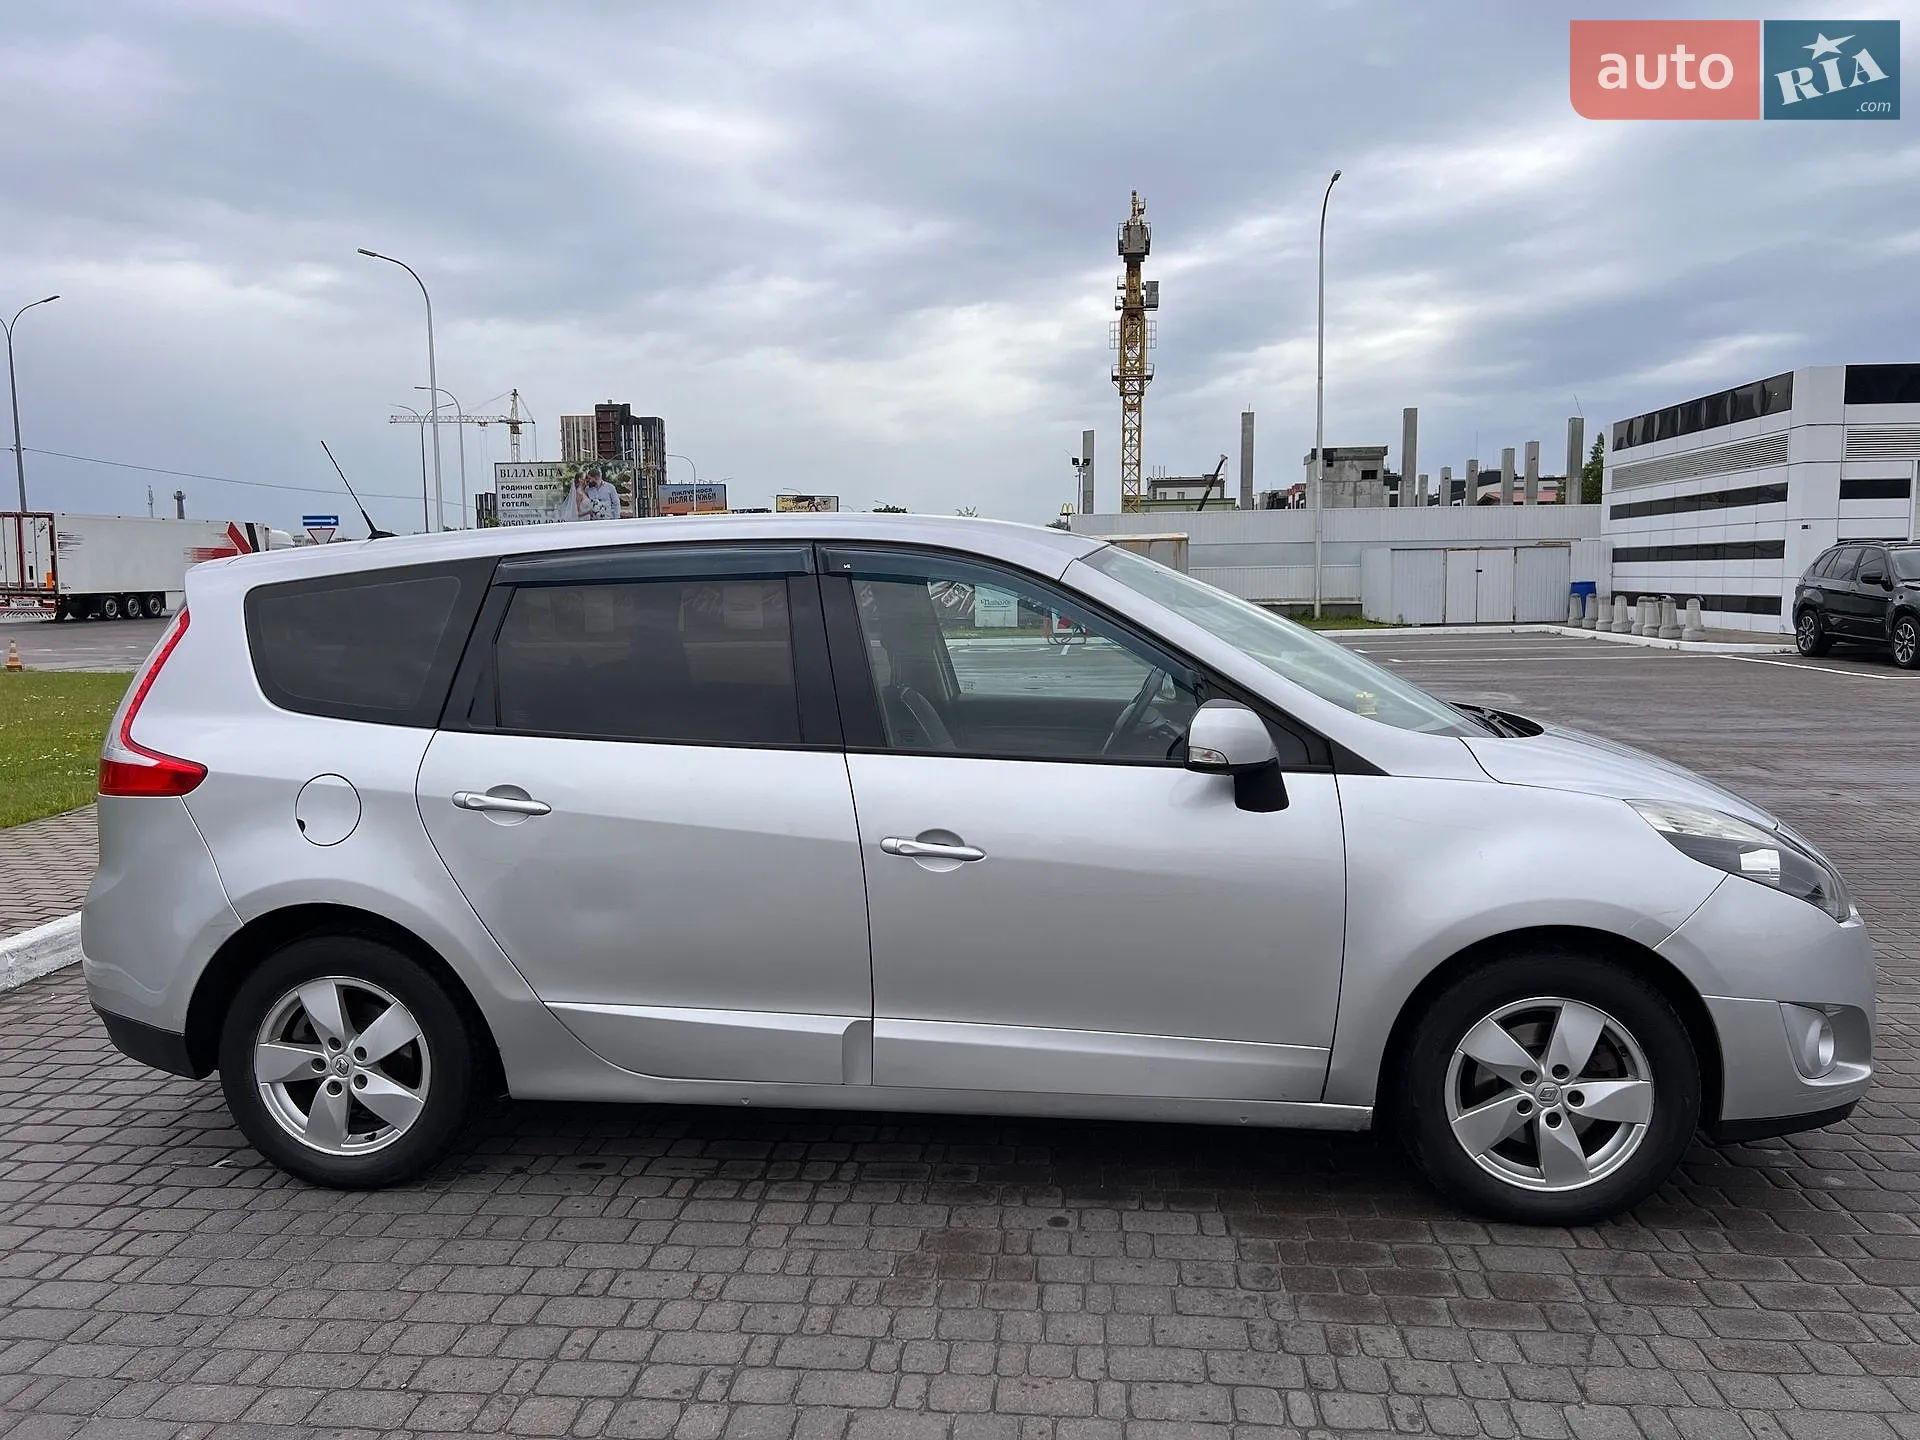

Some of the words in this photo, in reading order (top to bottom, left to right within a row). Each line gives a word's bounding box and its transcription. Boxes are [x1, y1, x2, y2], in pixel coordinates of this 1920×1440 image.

[500, 469, 534, 478] ВІЛЛА
[537, 468, 563, 477] ВІТА
[668, 495, 688, 504] ПІСЛЯ
